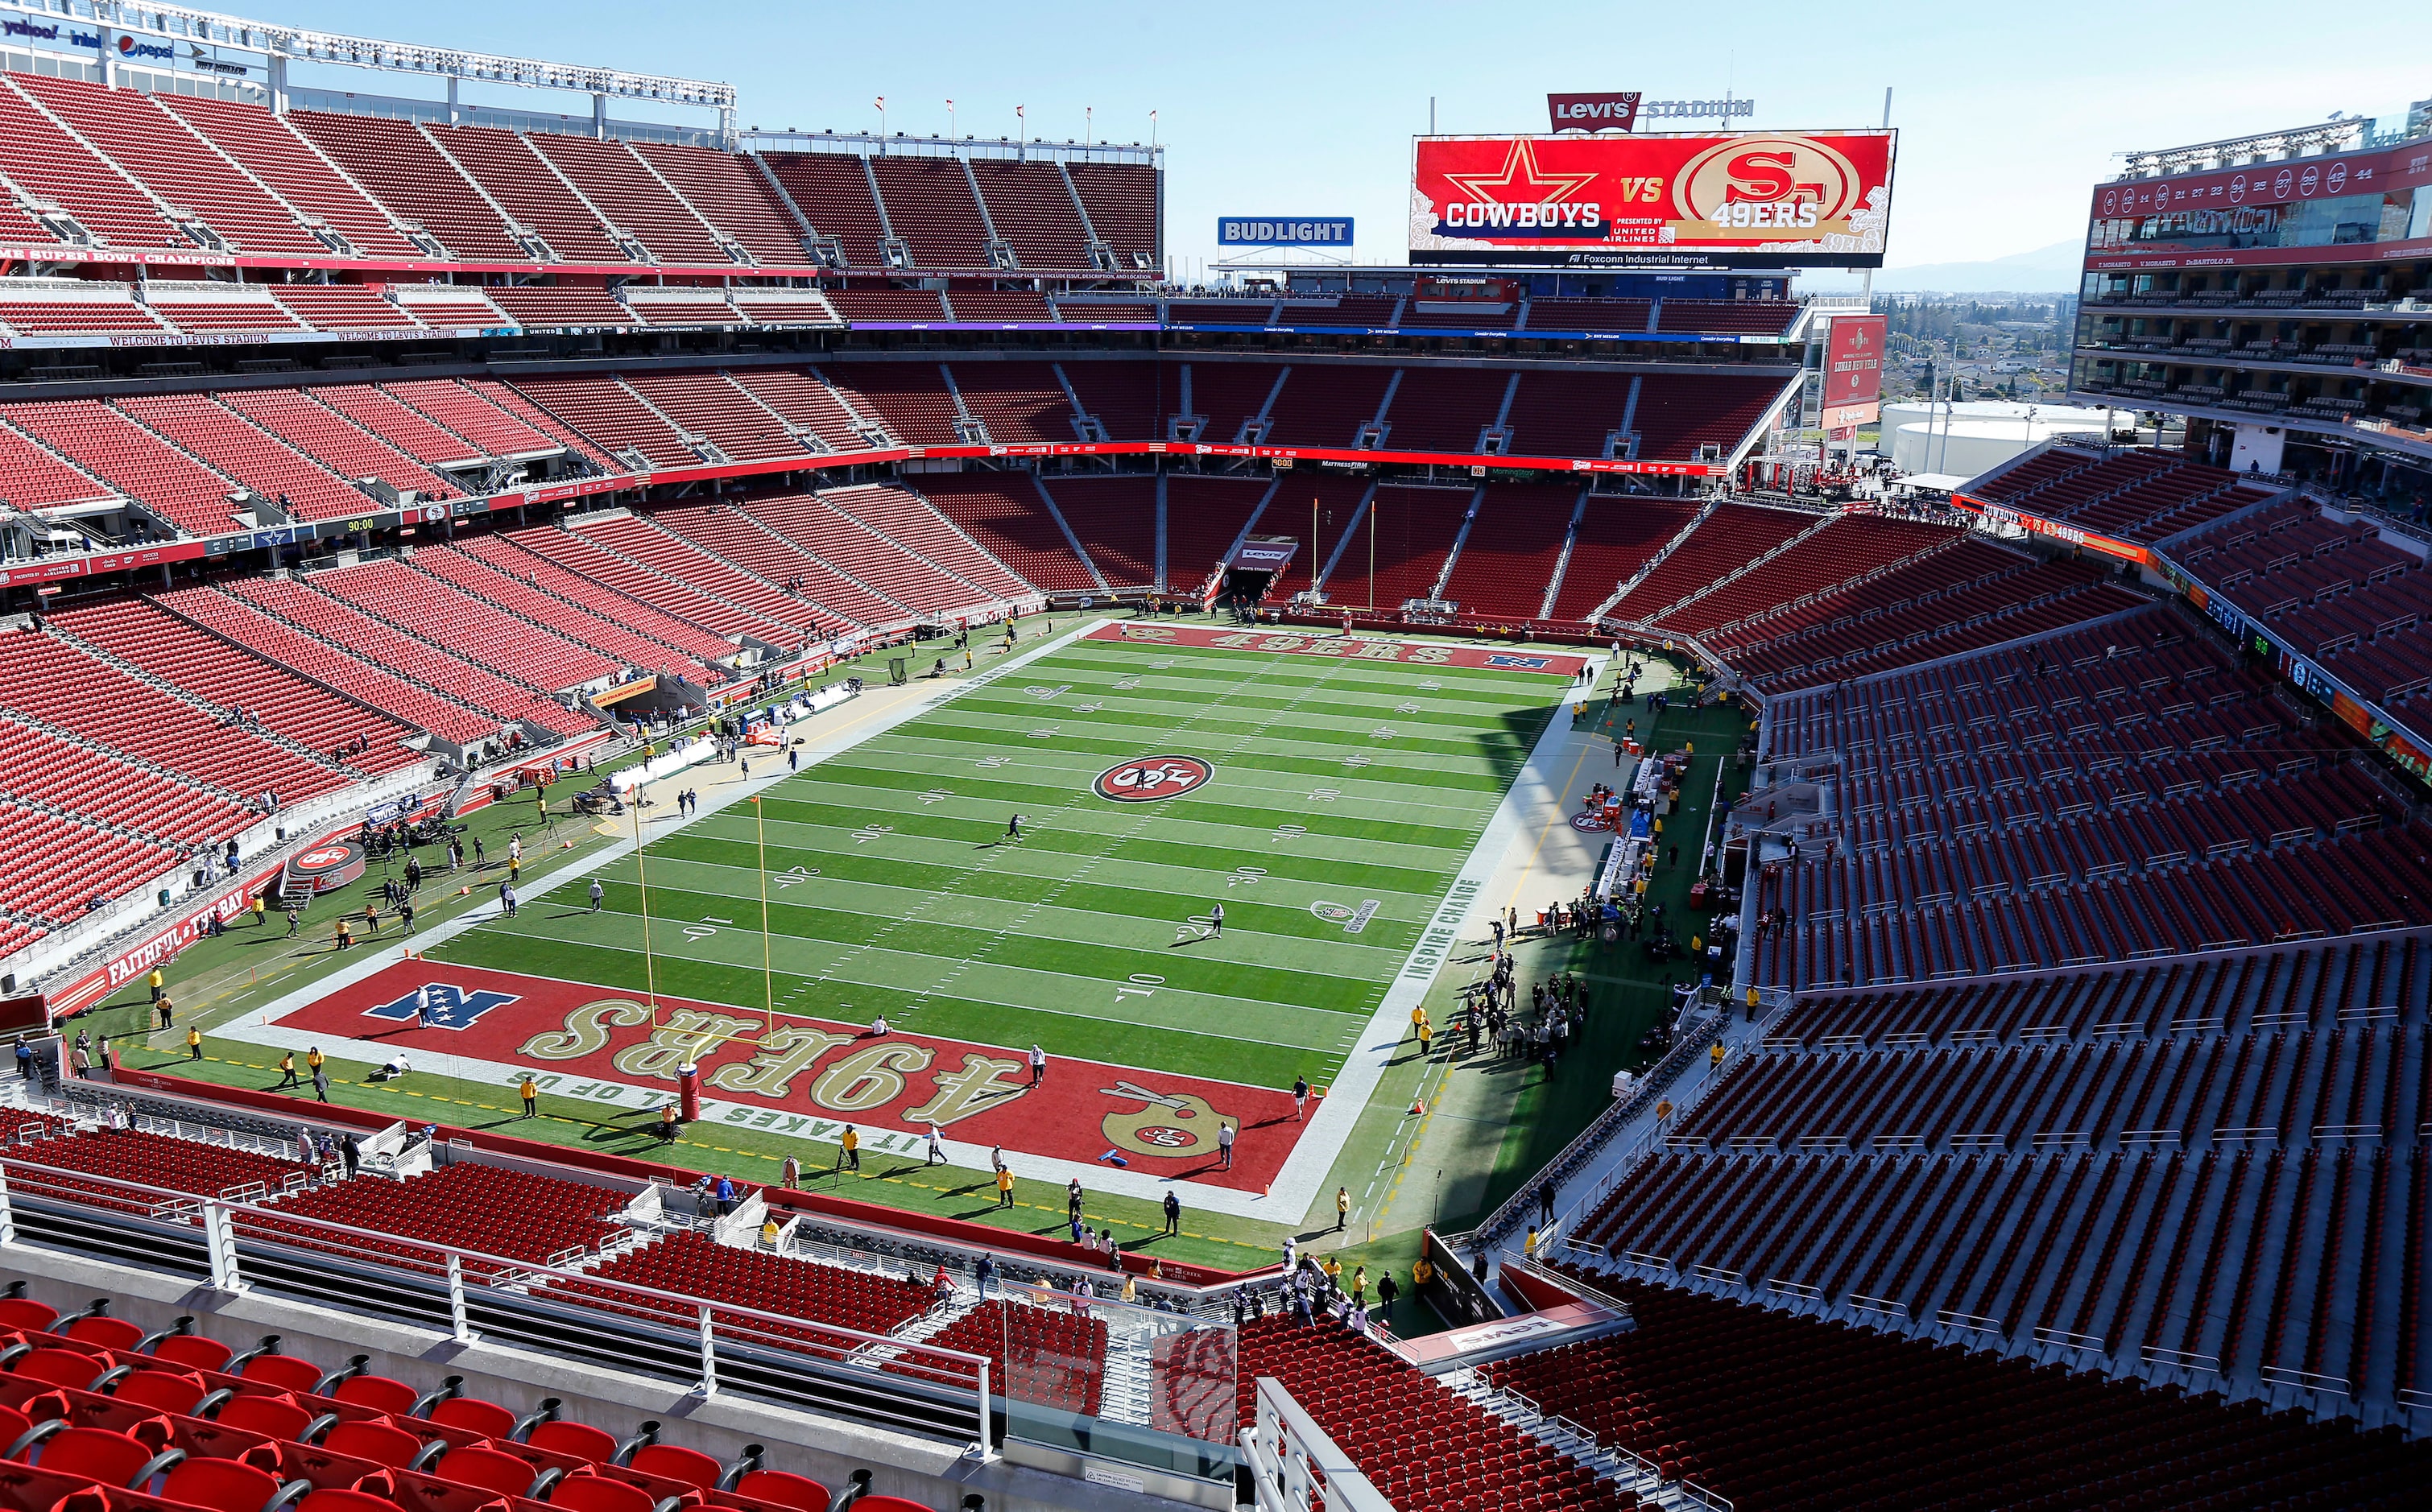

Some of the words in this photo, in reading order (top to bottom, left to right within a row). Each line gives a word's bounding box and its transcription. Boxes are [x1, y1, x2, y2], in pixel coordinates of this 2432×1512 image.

[1, 19, 60, 39] yahoo!
[70, 29, 102, 48] intel
[137, 43, 173, 59] pepsi
[1647, 99, 1754, 118] STADIUM
[1619, 177, 1665, 203] VS
[1446, 202, 1602, 228] COWBOYS
[1710, 202, 1818, 228] 49ERS
[1225, 222, 1273, 241] BUD
[1276, 222, 1346, 241] LIGHT
[30, 250, 89, 262] SUPER
[92, 252, 141, 263] BOWL
[145, 254, 236, 266] CHAMPIONS
[1583, 254, 1623, 266] Foxconn
[1625, 254, 1669, 264] Industrial
[1671, 255, 1709, 264] Internet
[110, 336, 167, 347] WELCOME
[170, 335, 182, 345] TO
[185, 335, 220, 345] LEVI'S
[223, 333, 270, 345] STADIUM
[337, 332, 380, 341] WELCOME
[381, 332, 392, 341] TO
[393, 331, 421, 340] LEVI'S
[422, 330, 457, 339] STADIUM
[1834, 361, 1851, 372] LUNAR
[1852, 360, 1864, 370] NEW
[1864, 359, 1877, 370] YEAR
[348, 518, 374, 532] 90:00
[1983, 504, 2019, 524] COWBOYS
[2033, 518, 2041, 531] VS
[2057, 525, 2084, 544] 49ERS
[14, 572, 34, 580] PRESENTED
[43, 568, 70, 576] AIRLINES
[1211, 632, 1454, 663] 49ERS
[1112, 680, 1140, 690] 20
[608, 688, 636, 701] FRANCISCO
[1072, 702, 1102, 713] 30
[1394, 705, 1421, 714] 20
[1368, 729, 1398, 740] 30
[975, 755, 1011, 768] 50
[1341, 756, 1371, 768] 40
[917, 787, 955, 803] 40
[1307, 788, 1342, 802] 50
[850, 823, 894, 841] 30
[1275, 824, 1308, 840] 40
[773, 865, 821, 886] 20
[1226, 865, 1268, 886] 30
[1347, 899, 1379, 933] DIVISIONAL
[682, 915, 734, 937] 10
[1177, 915, 1215, 937] 20
[1404, 927, 1450, 981] INSPIRE
[1437, 879, 1482, 925] CHANGE
[109, 928, 183, 985] FAITHFUL
[218, 888, 243, 919] BAY
[1115, 973, 1167, 998] 10
[516, 998, 1028, 1127] 49ERS
[507, 1070, 563, 1090] US
[569, 1080, 623, 1101] OF
